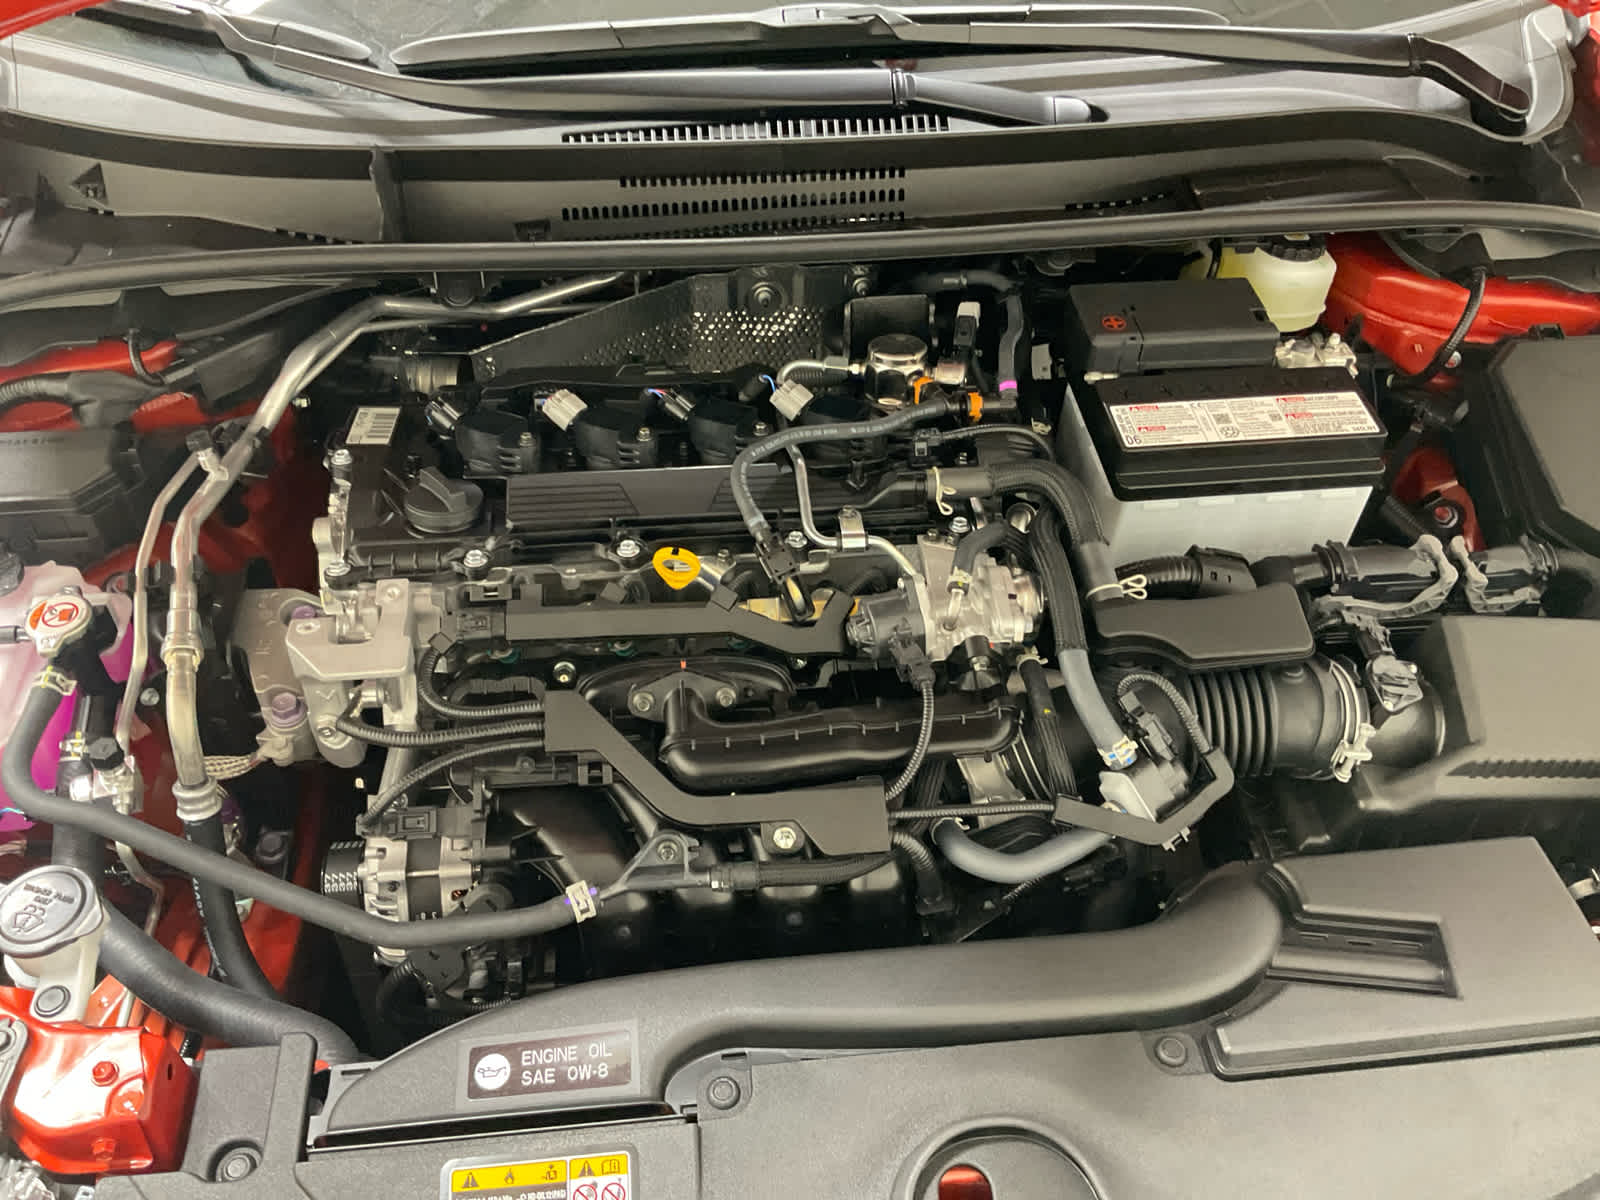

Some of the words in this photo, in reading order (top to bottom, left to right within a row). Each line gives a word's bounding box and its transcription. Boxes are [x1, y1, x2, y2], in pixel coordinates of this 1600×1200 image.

[521, 1045, 578, 1066] ENGINE
[588, 1040, 613, 1059] OIL
[521, 1067, 556, 1086] SAE
[567, 1062, 609, 1081] 0W-8
